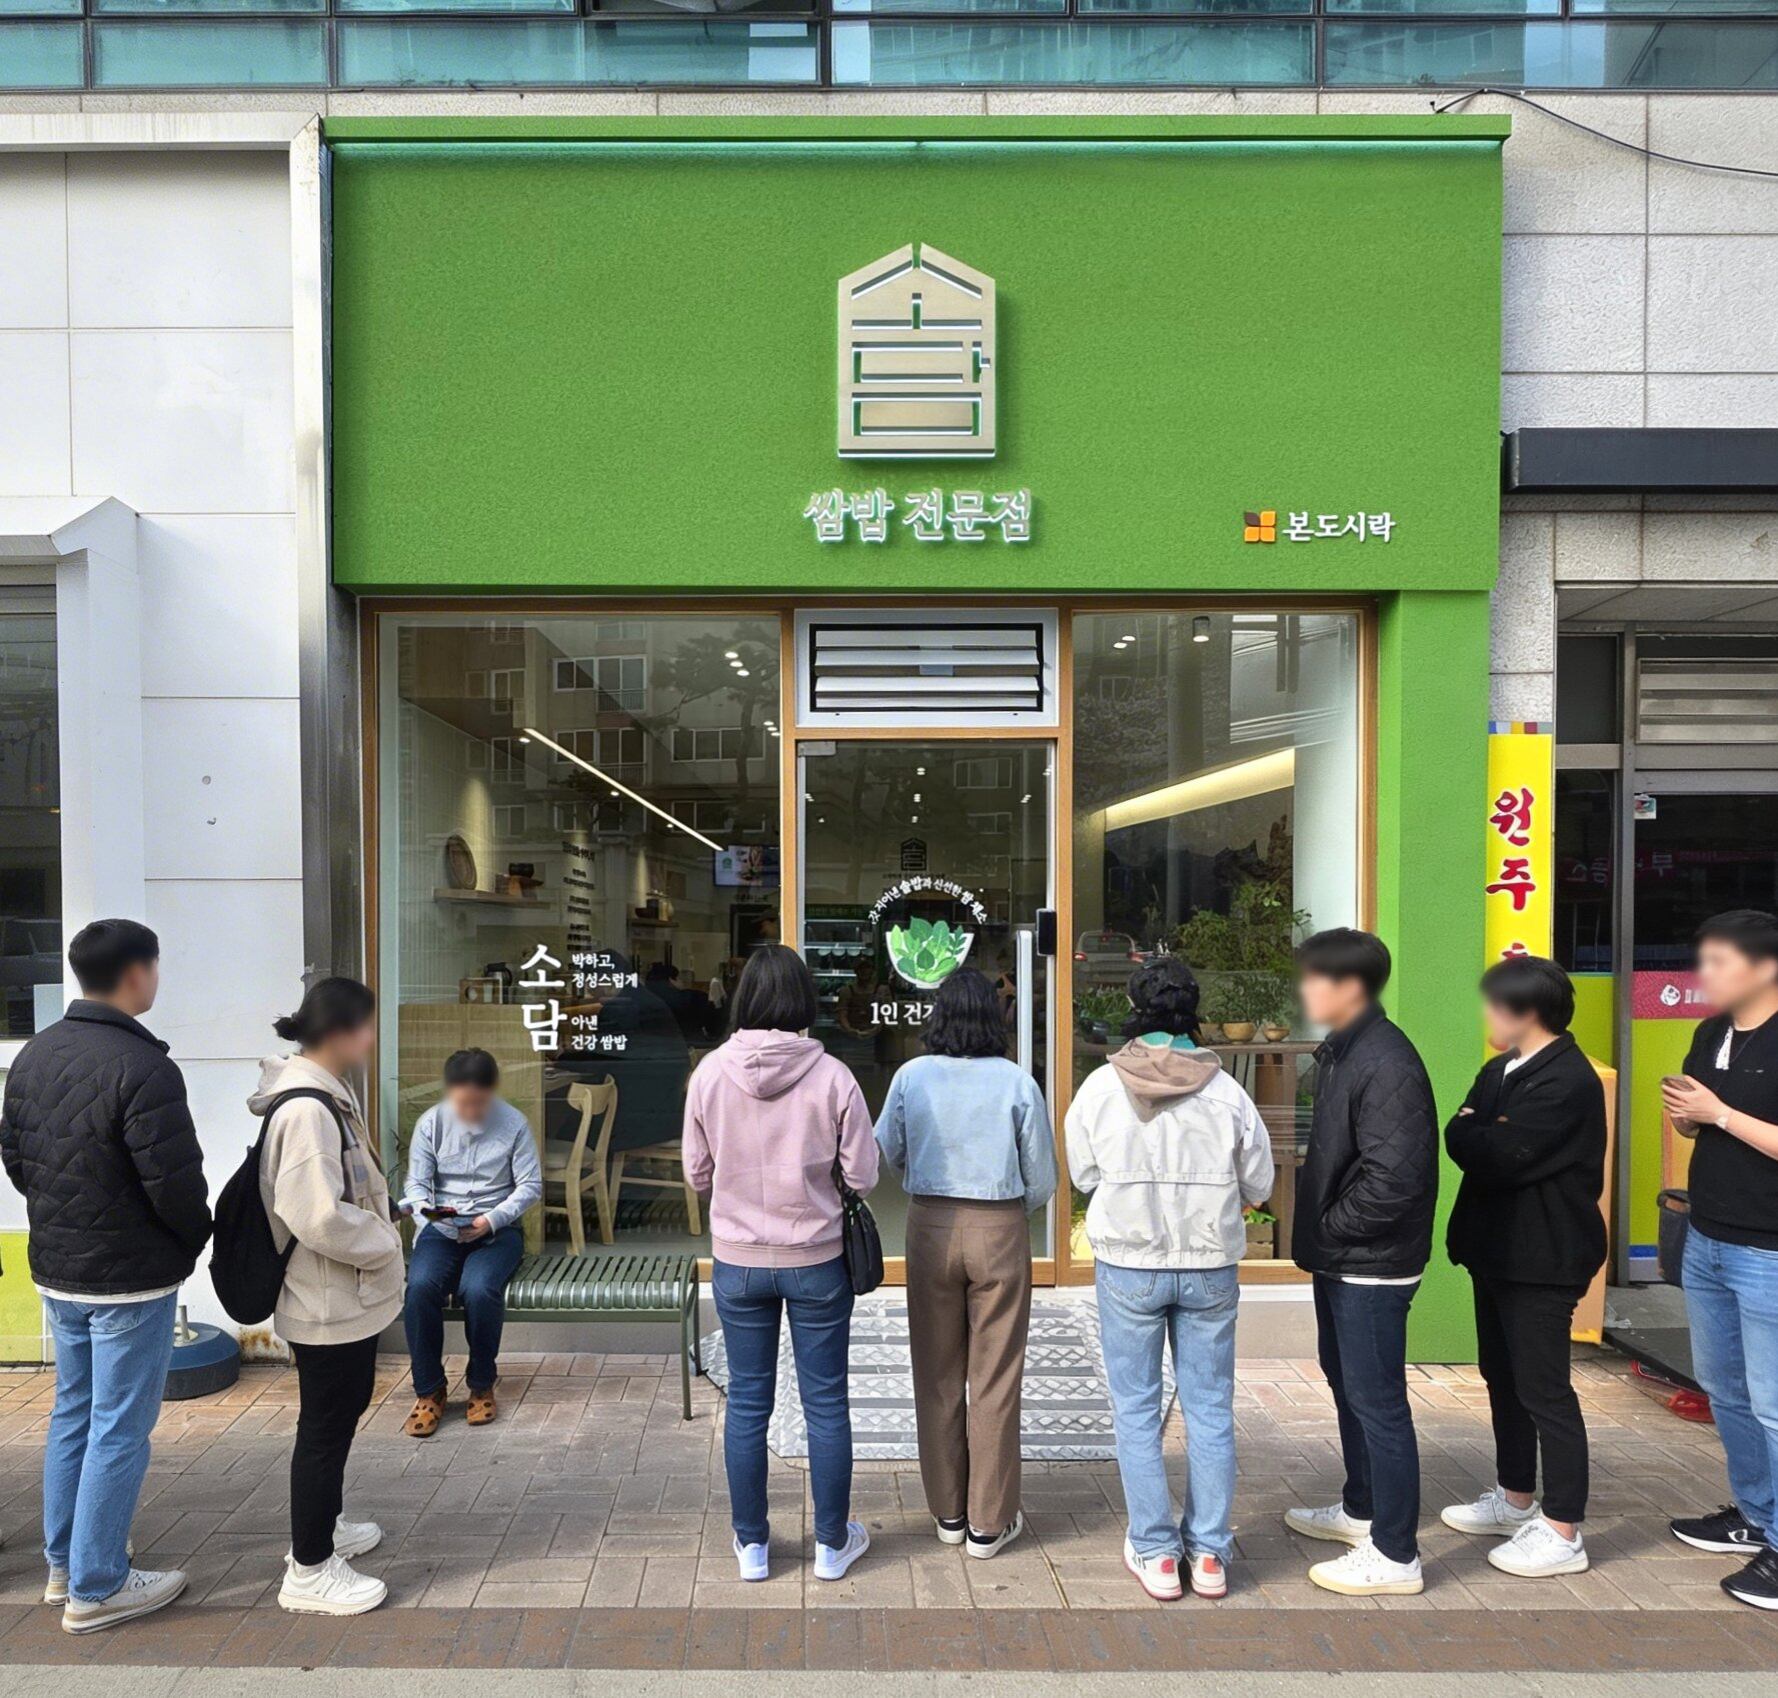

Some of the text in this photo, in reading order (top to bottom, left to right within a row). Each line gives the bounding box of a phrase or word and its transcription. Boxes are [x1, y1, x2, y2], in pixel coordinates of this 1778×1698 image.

[803, 487, 1032, 543] 쌈밥 전문점
[1282, 511, 1396, 543] 본도시락
[933, 879, 962, 897] 신선한
[970, 901, 988, 925] 채소
[572, 953, 615, 969] 박하고,
[572, 972, 639, 989] 정성스럽게
[571, 1014, 598, 1031] 아낸
[870, 1001, 898, 1025] 1인
[571, 1034, 628, 1051] 건강 쌈밥
